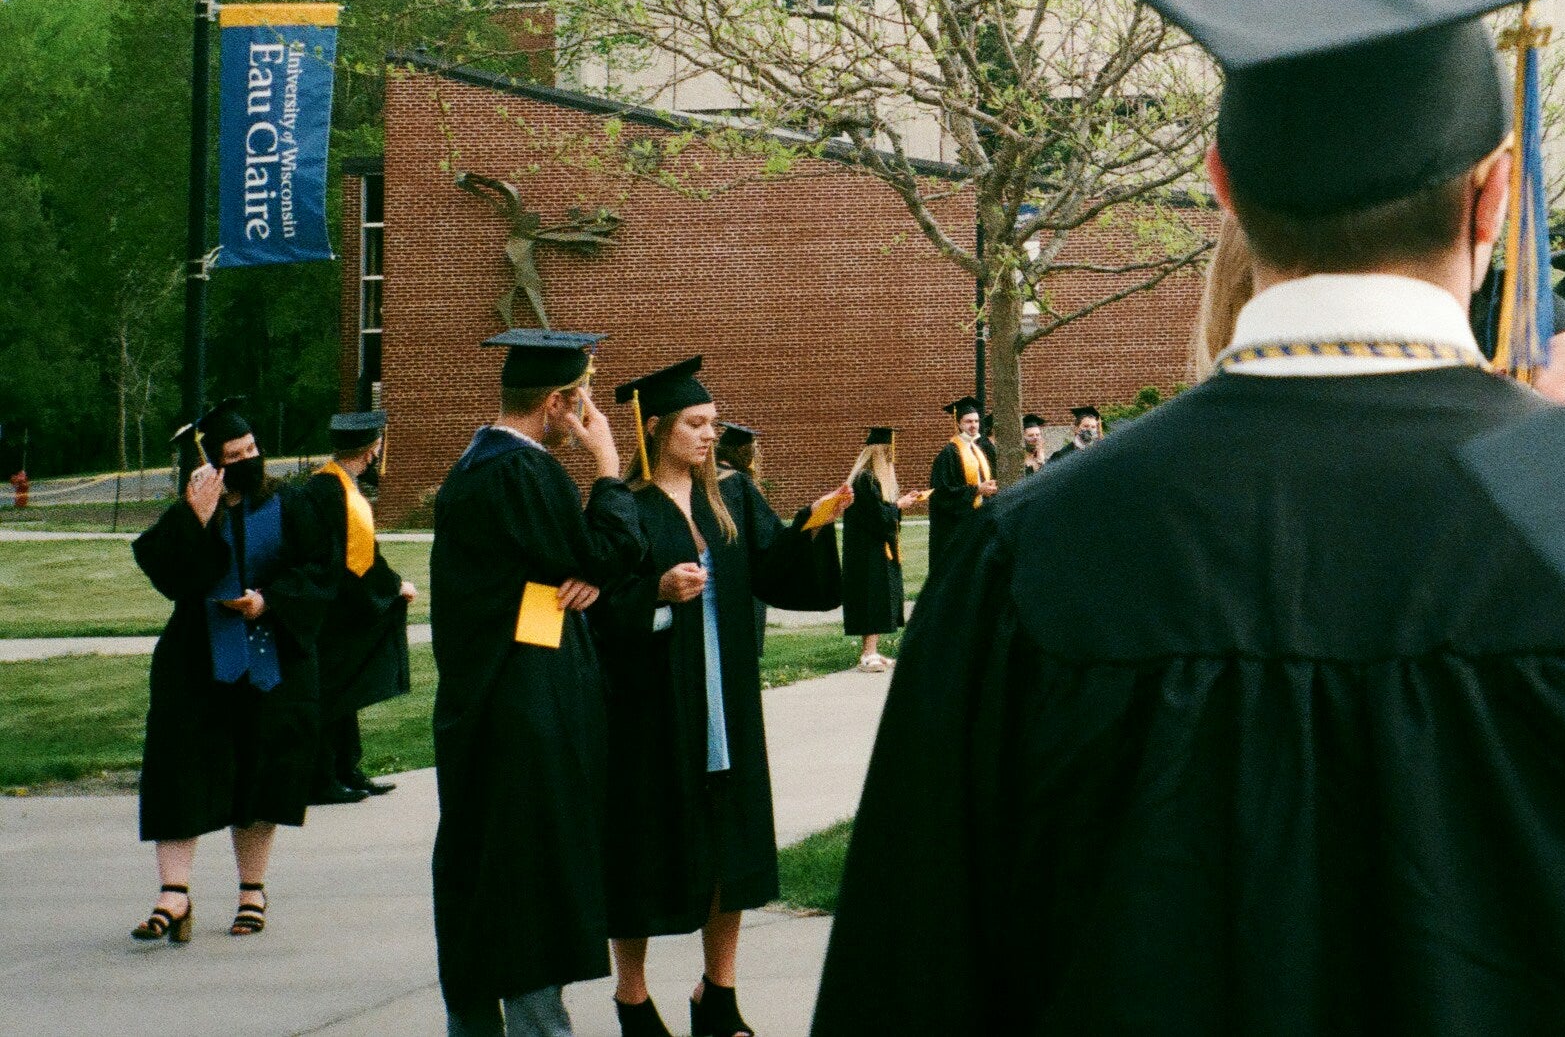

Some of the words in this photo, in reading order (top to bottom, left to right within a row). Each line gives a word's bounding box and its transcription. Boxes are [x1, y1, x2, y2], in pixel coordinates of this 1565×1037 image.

[247, 42, 284, 116] Eau
[279, 42, 305, 130] University
[245, 121, 279, 241] Claire
[280, 131, 297, 145] of
[281, 147, 299, 238] Wisconsin
